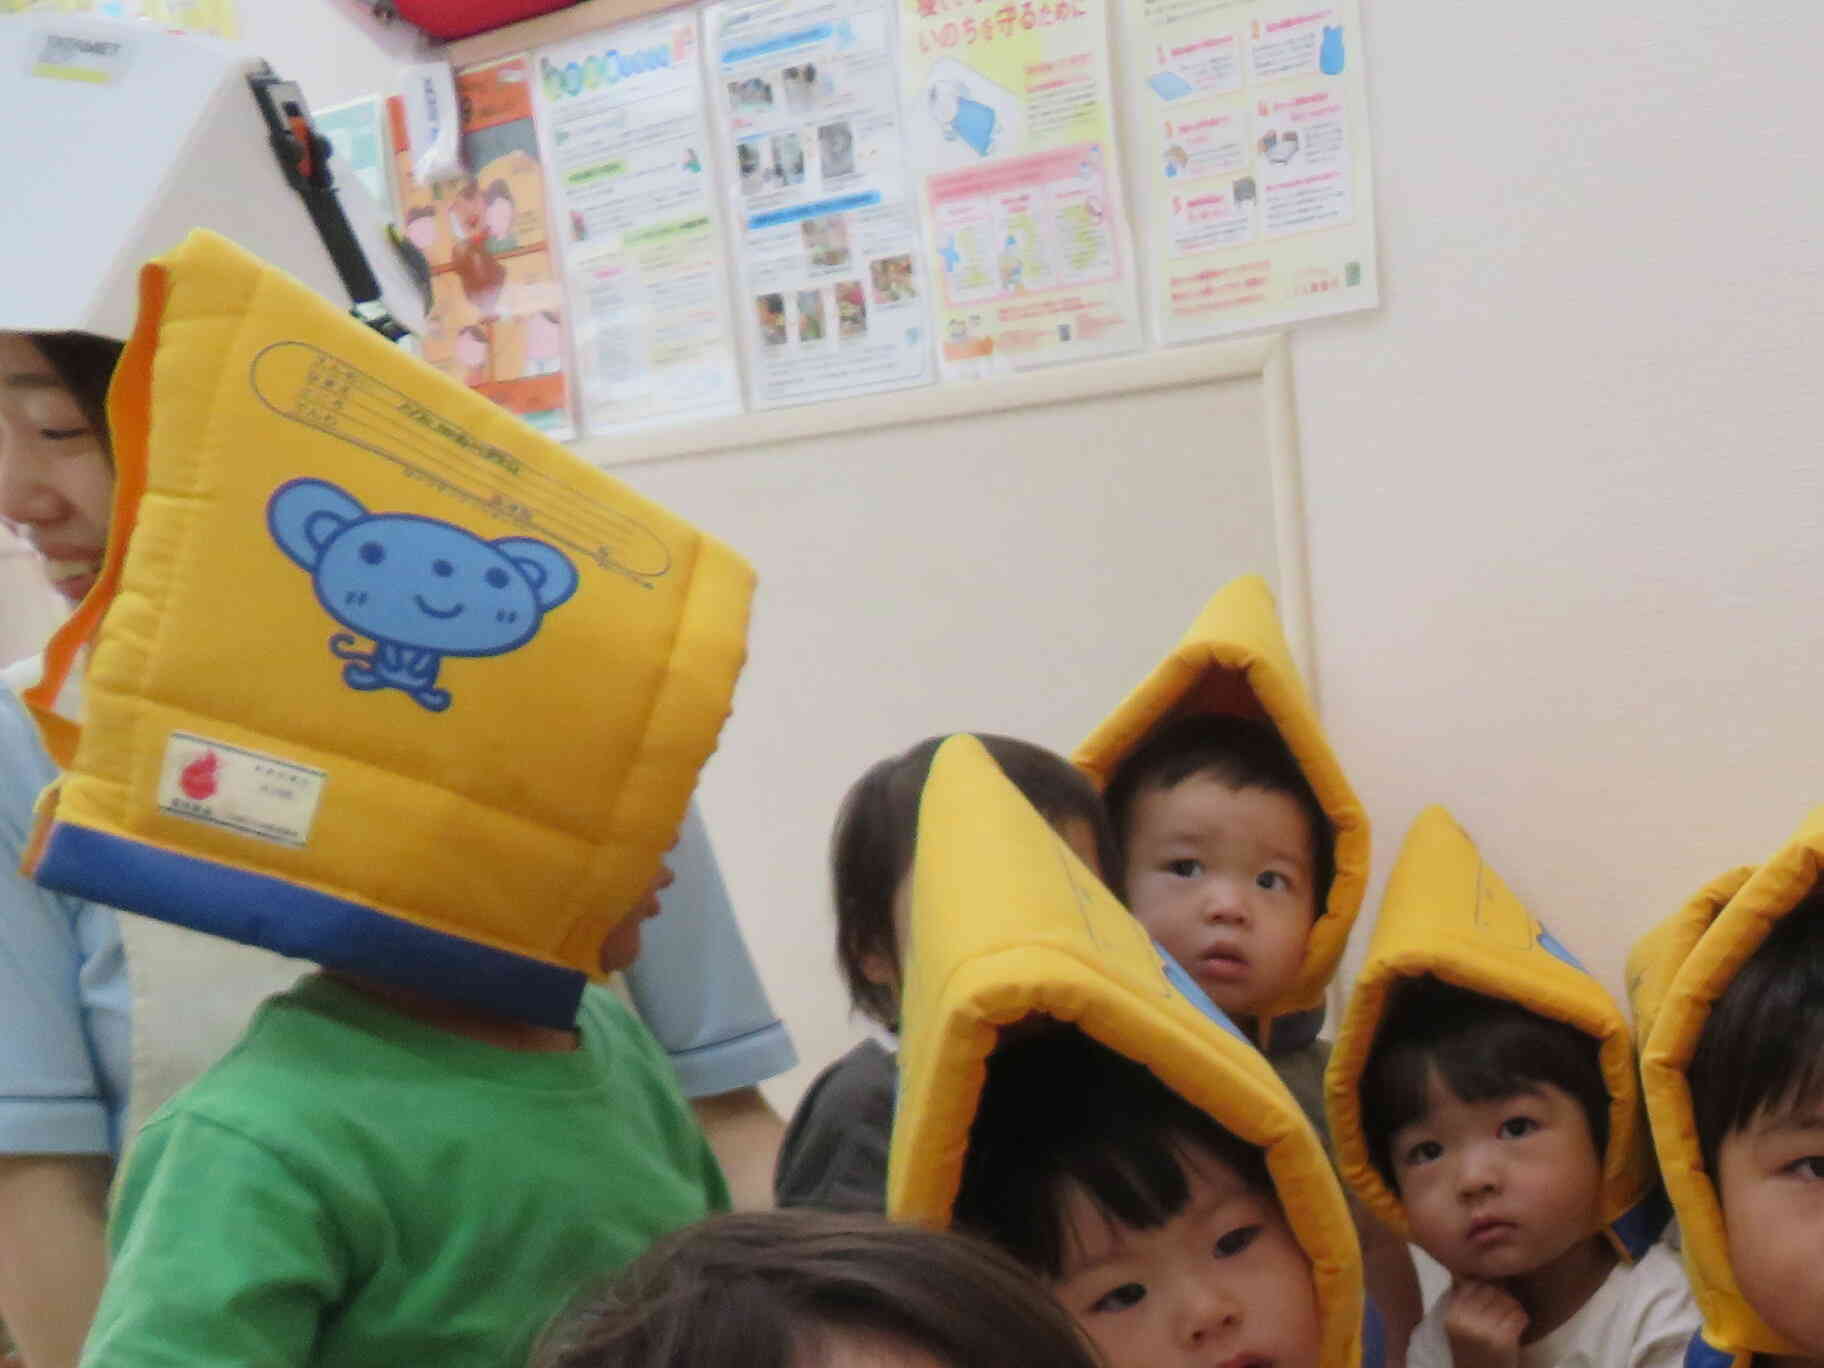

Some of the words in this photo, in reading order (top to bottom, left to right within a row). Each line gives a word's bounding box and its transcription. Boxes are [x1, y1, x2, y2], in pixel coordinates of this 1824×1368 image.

[918, 1, 1089, 54] いのちを守るために
